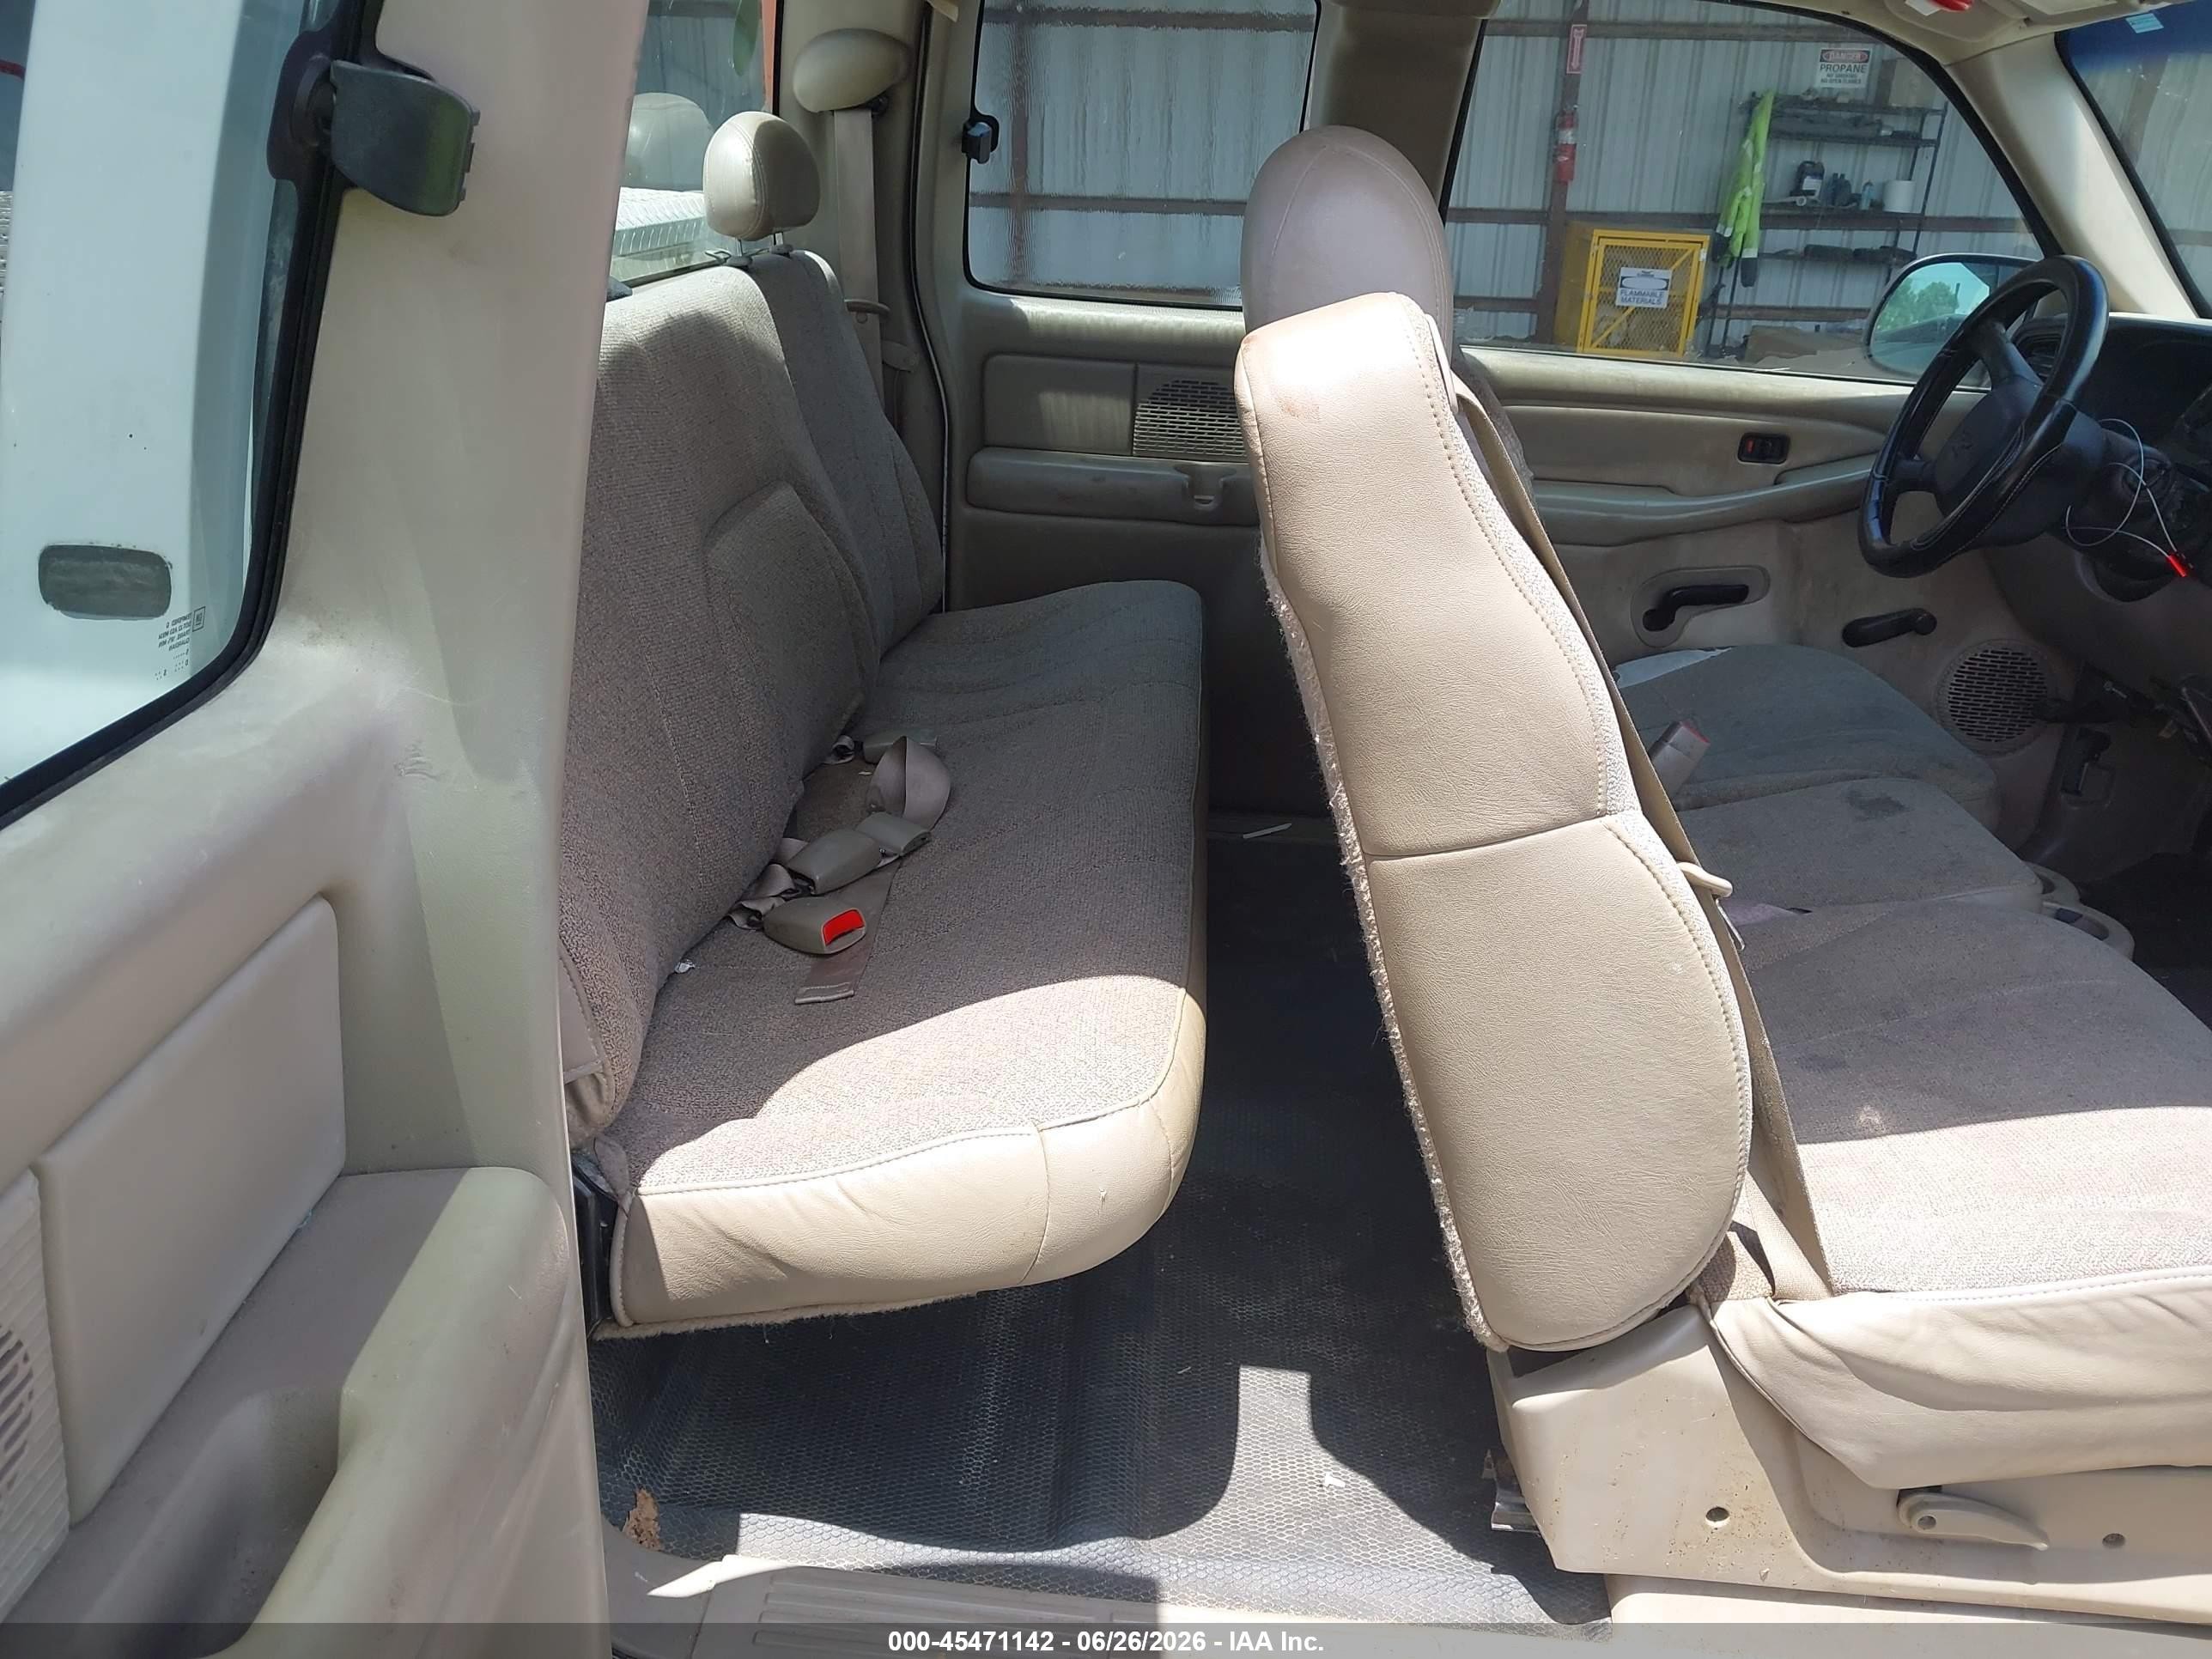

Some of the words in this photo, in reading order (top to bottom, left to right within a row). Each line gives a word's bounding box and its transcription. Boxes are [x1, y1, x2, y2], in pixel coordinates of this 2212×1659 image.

[1829, 52, 1860, 61] DANGER
[1820, 64, 1868, 73] PROPANE
[1620, 289, 1663, 298] FLAMMABLE
[1620, 296, 1662, 305] MATERIALS
